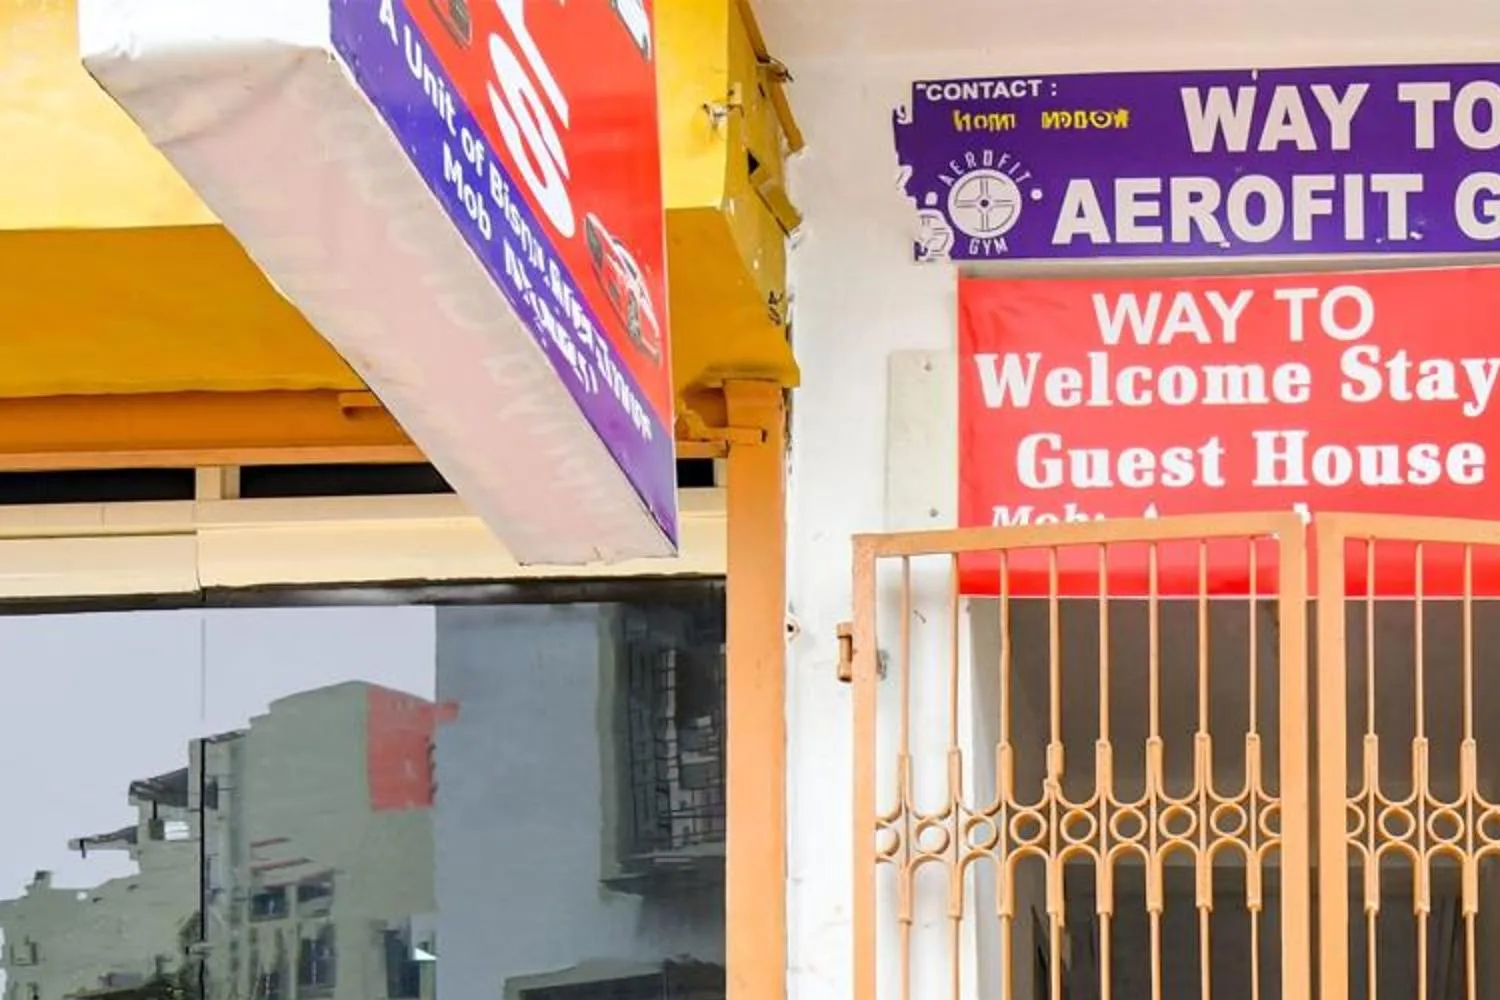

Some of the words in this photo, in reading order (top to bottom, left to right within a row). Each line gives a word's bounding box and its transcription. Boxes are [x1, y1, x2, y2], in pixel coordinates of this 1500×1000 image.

[404, 25, 456, 136] Unit
[461, 127, 484, 176] of
[925, 79, 1043, 101] CONTACT
[1180, 80, 1369, 152] WAY
[443, 140, 492, 240] Mob
[937, 150, 1032, 187] AEROFIT
[1052, 172, 1422, 245] AEROFIT
[968, 238, 1009, 256] GYM
[1093, 289, 1255, 344] WAY
[1274, 285, 1375, 341] TO
[975, 352, 1312, 408] Welcome
[1016, 432, 1225, 489] Guest
[1252, 429, 1488, 487] House
